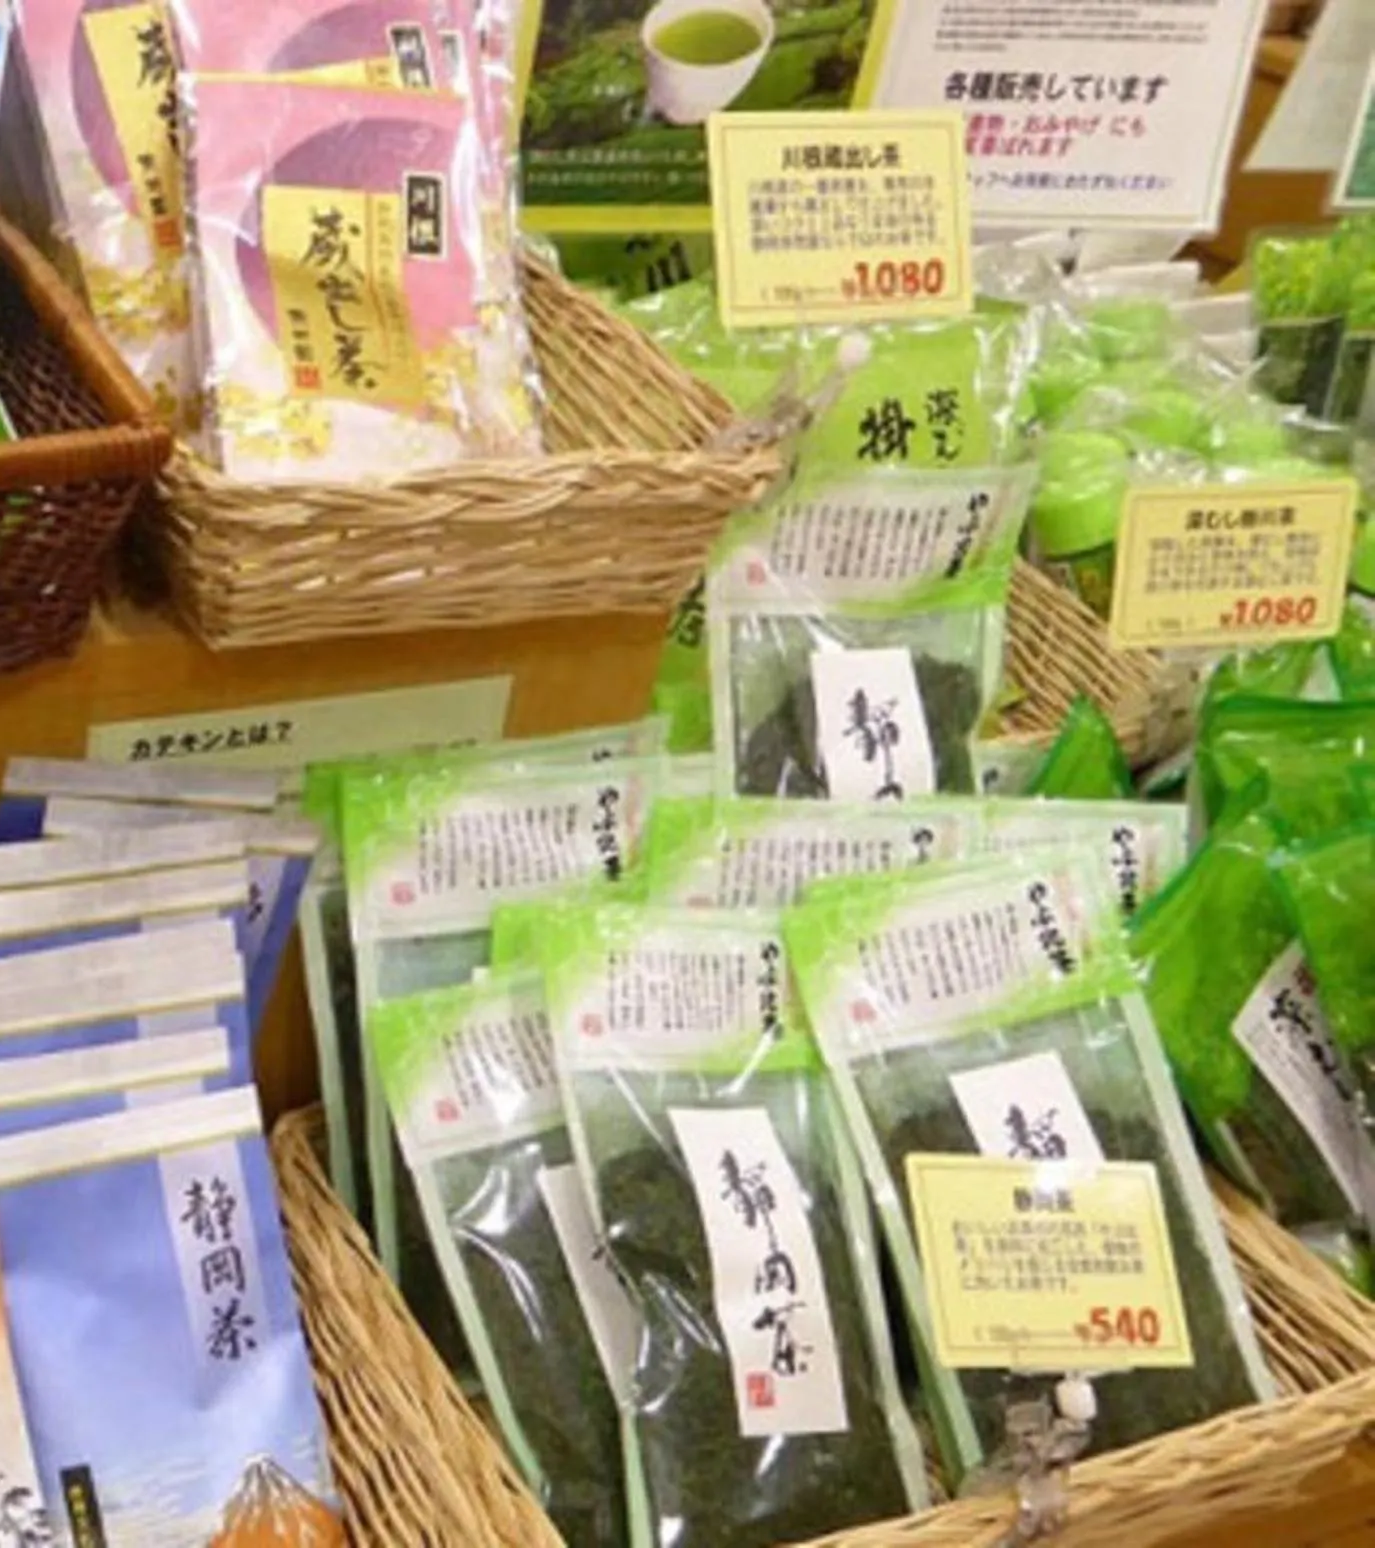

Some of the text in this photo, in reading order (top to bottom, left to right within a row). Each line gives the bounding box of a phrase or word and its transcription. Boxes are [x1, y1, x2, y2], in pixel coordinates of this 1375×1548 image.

[944, 72, 1169, 104] 各種販売しています
[180, 1176, 258, 1361] 静岡茶
